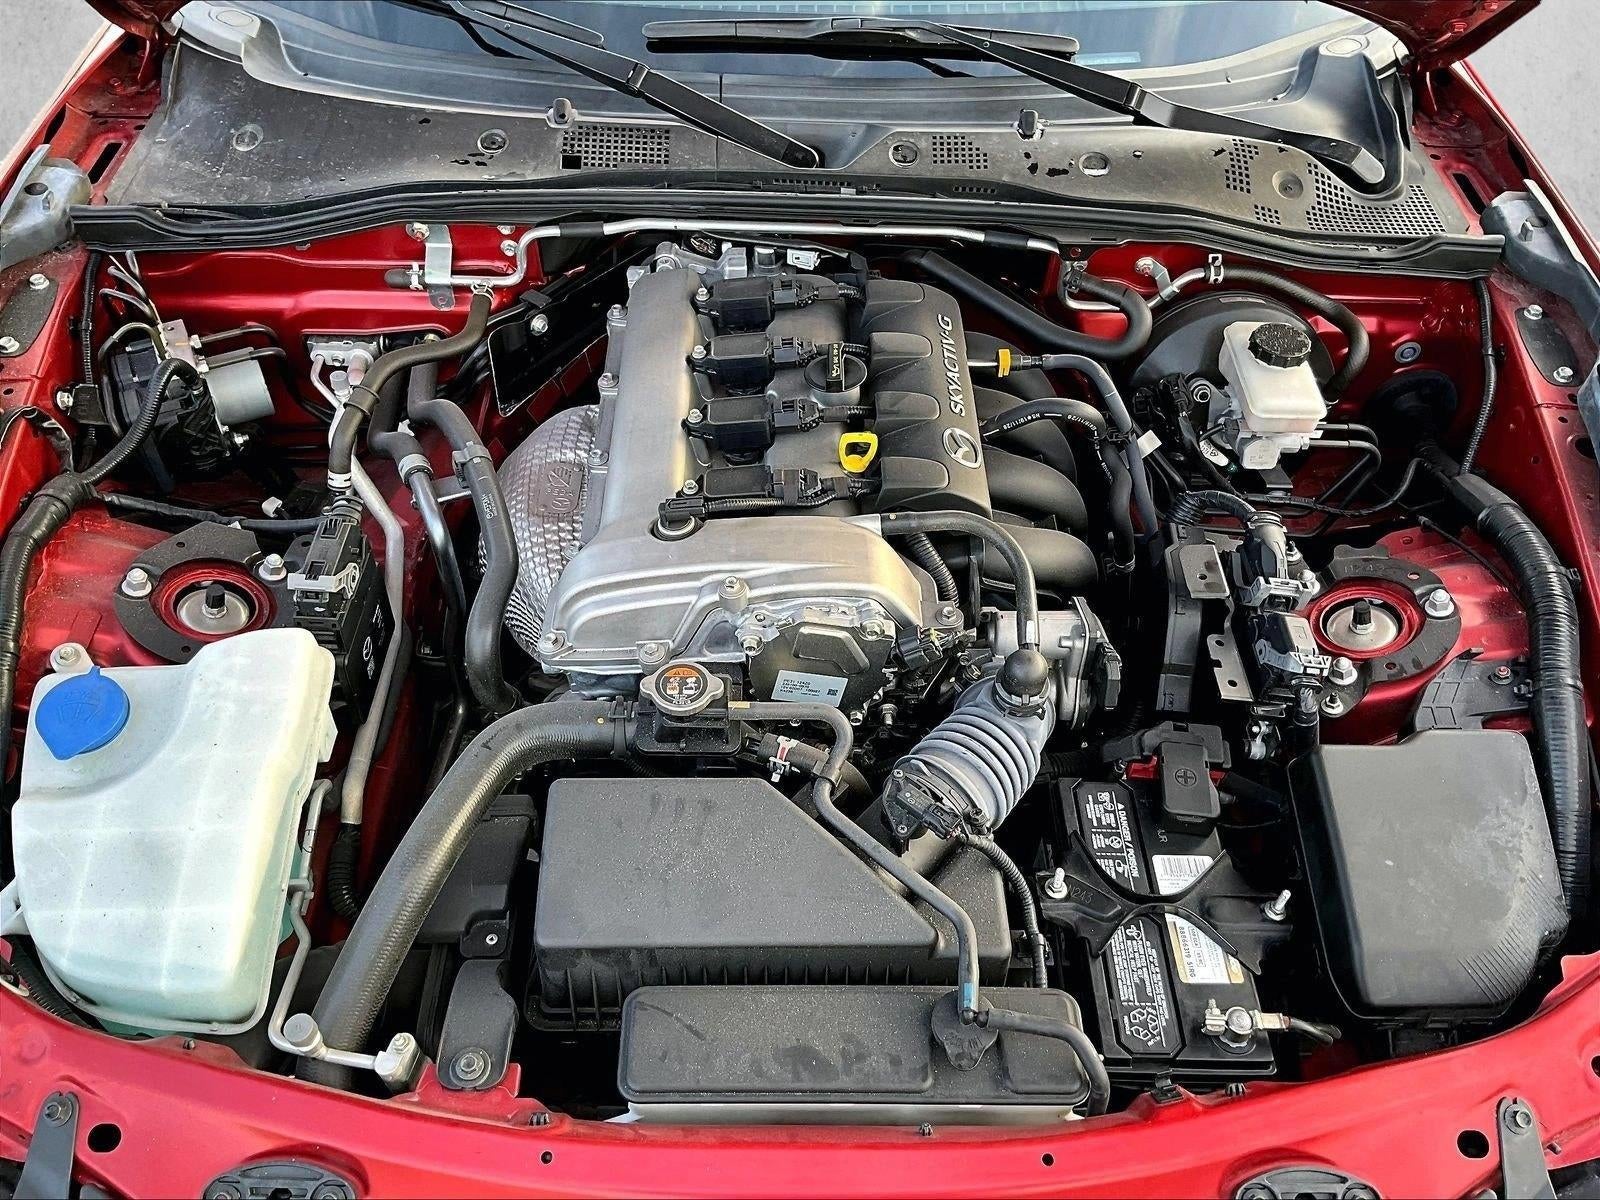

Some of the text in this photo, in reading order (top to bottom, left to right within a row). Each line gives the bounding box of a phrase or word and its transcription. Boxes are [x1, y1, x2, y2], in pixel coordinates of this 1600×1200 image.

[938, 313, 965, 417] SKYACTIV-G
[1118, 810, 1132, 841] DANGER
[1126, 849, 1140, 877] POISON
